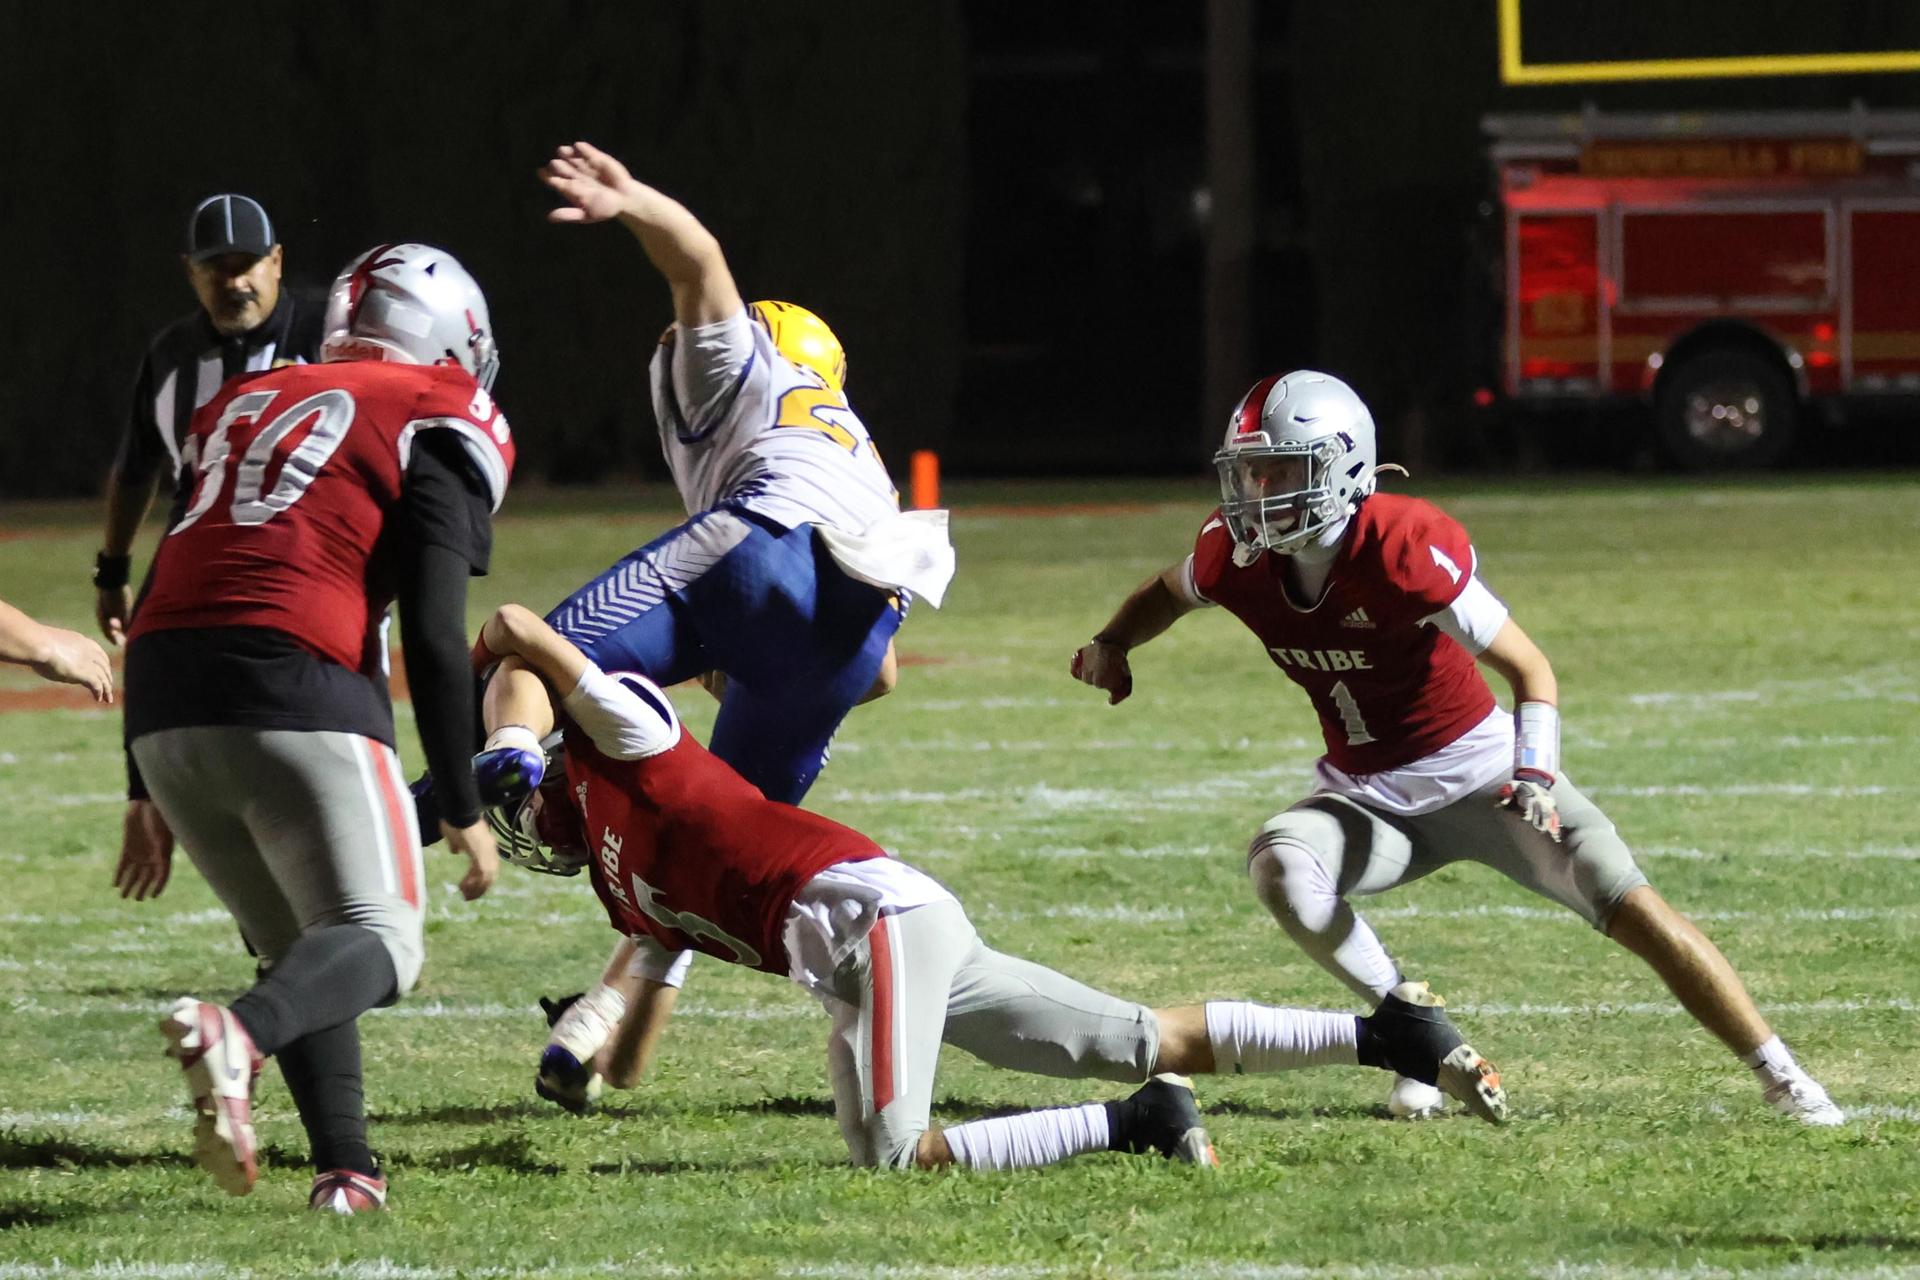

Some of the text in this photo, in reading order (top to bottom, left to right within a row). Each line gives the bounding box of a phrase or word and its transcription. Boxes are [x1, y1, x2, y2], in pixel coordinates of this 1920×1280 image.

[1429, 545, 1462, 585] 1
[1270, 648, 1374, 671] TRIBE
[1329, 680, 1378, 746] 1
